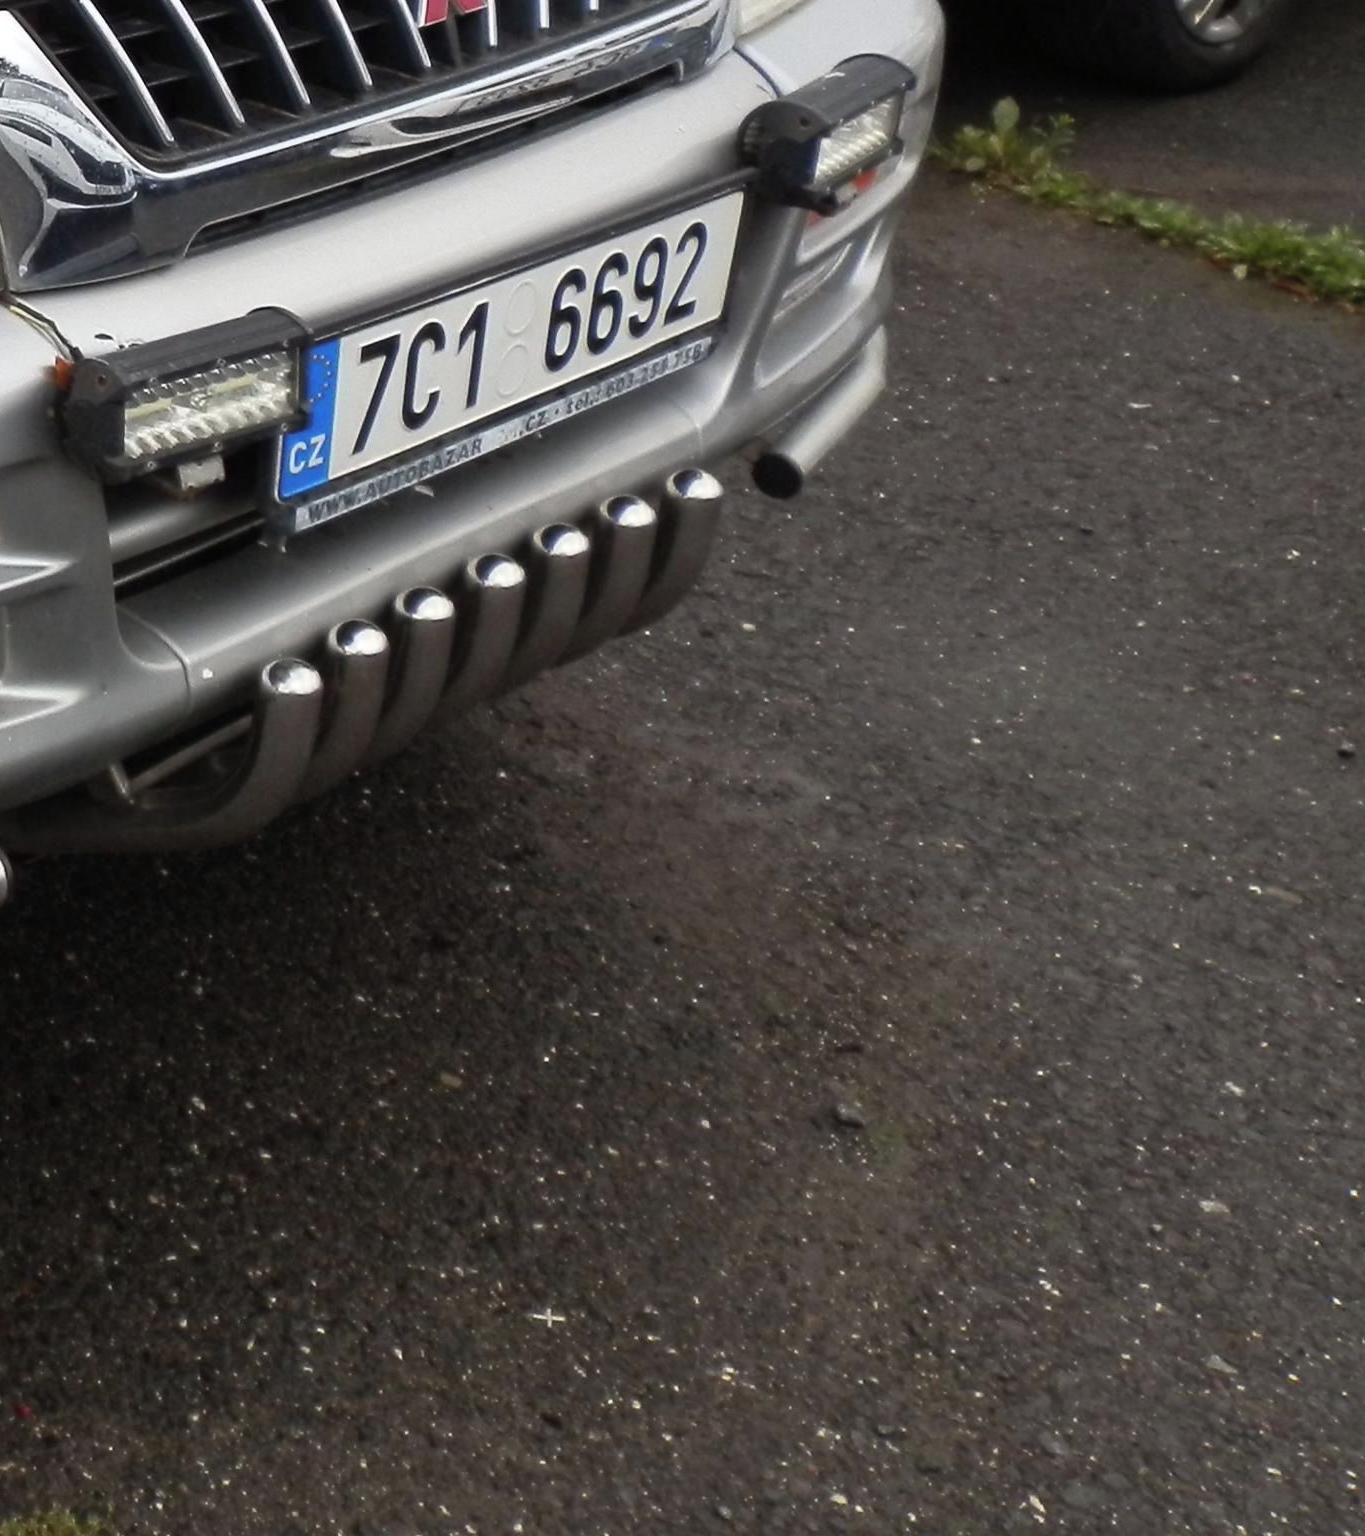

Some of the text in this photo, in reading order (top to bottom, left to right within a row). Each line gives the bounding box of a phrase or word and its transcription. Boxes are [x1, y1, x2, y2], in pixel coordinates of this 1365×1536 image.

[350, 220, 710, 456] 7C1 6692
[287, 432, 327, 476] CZ
